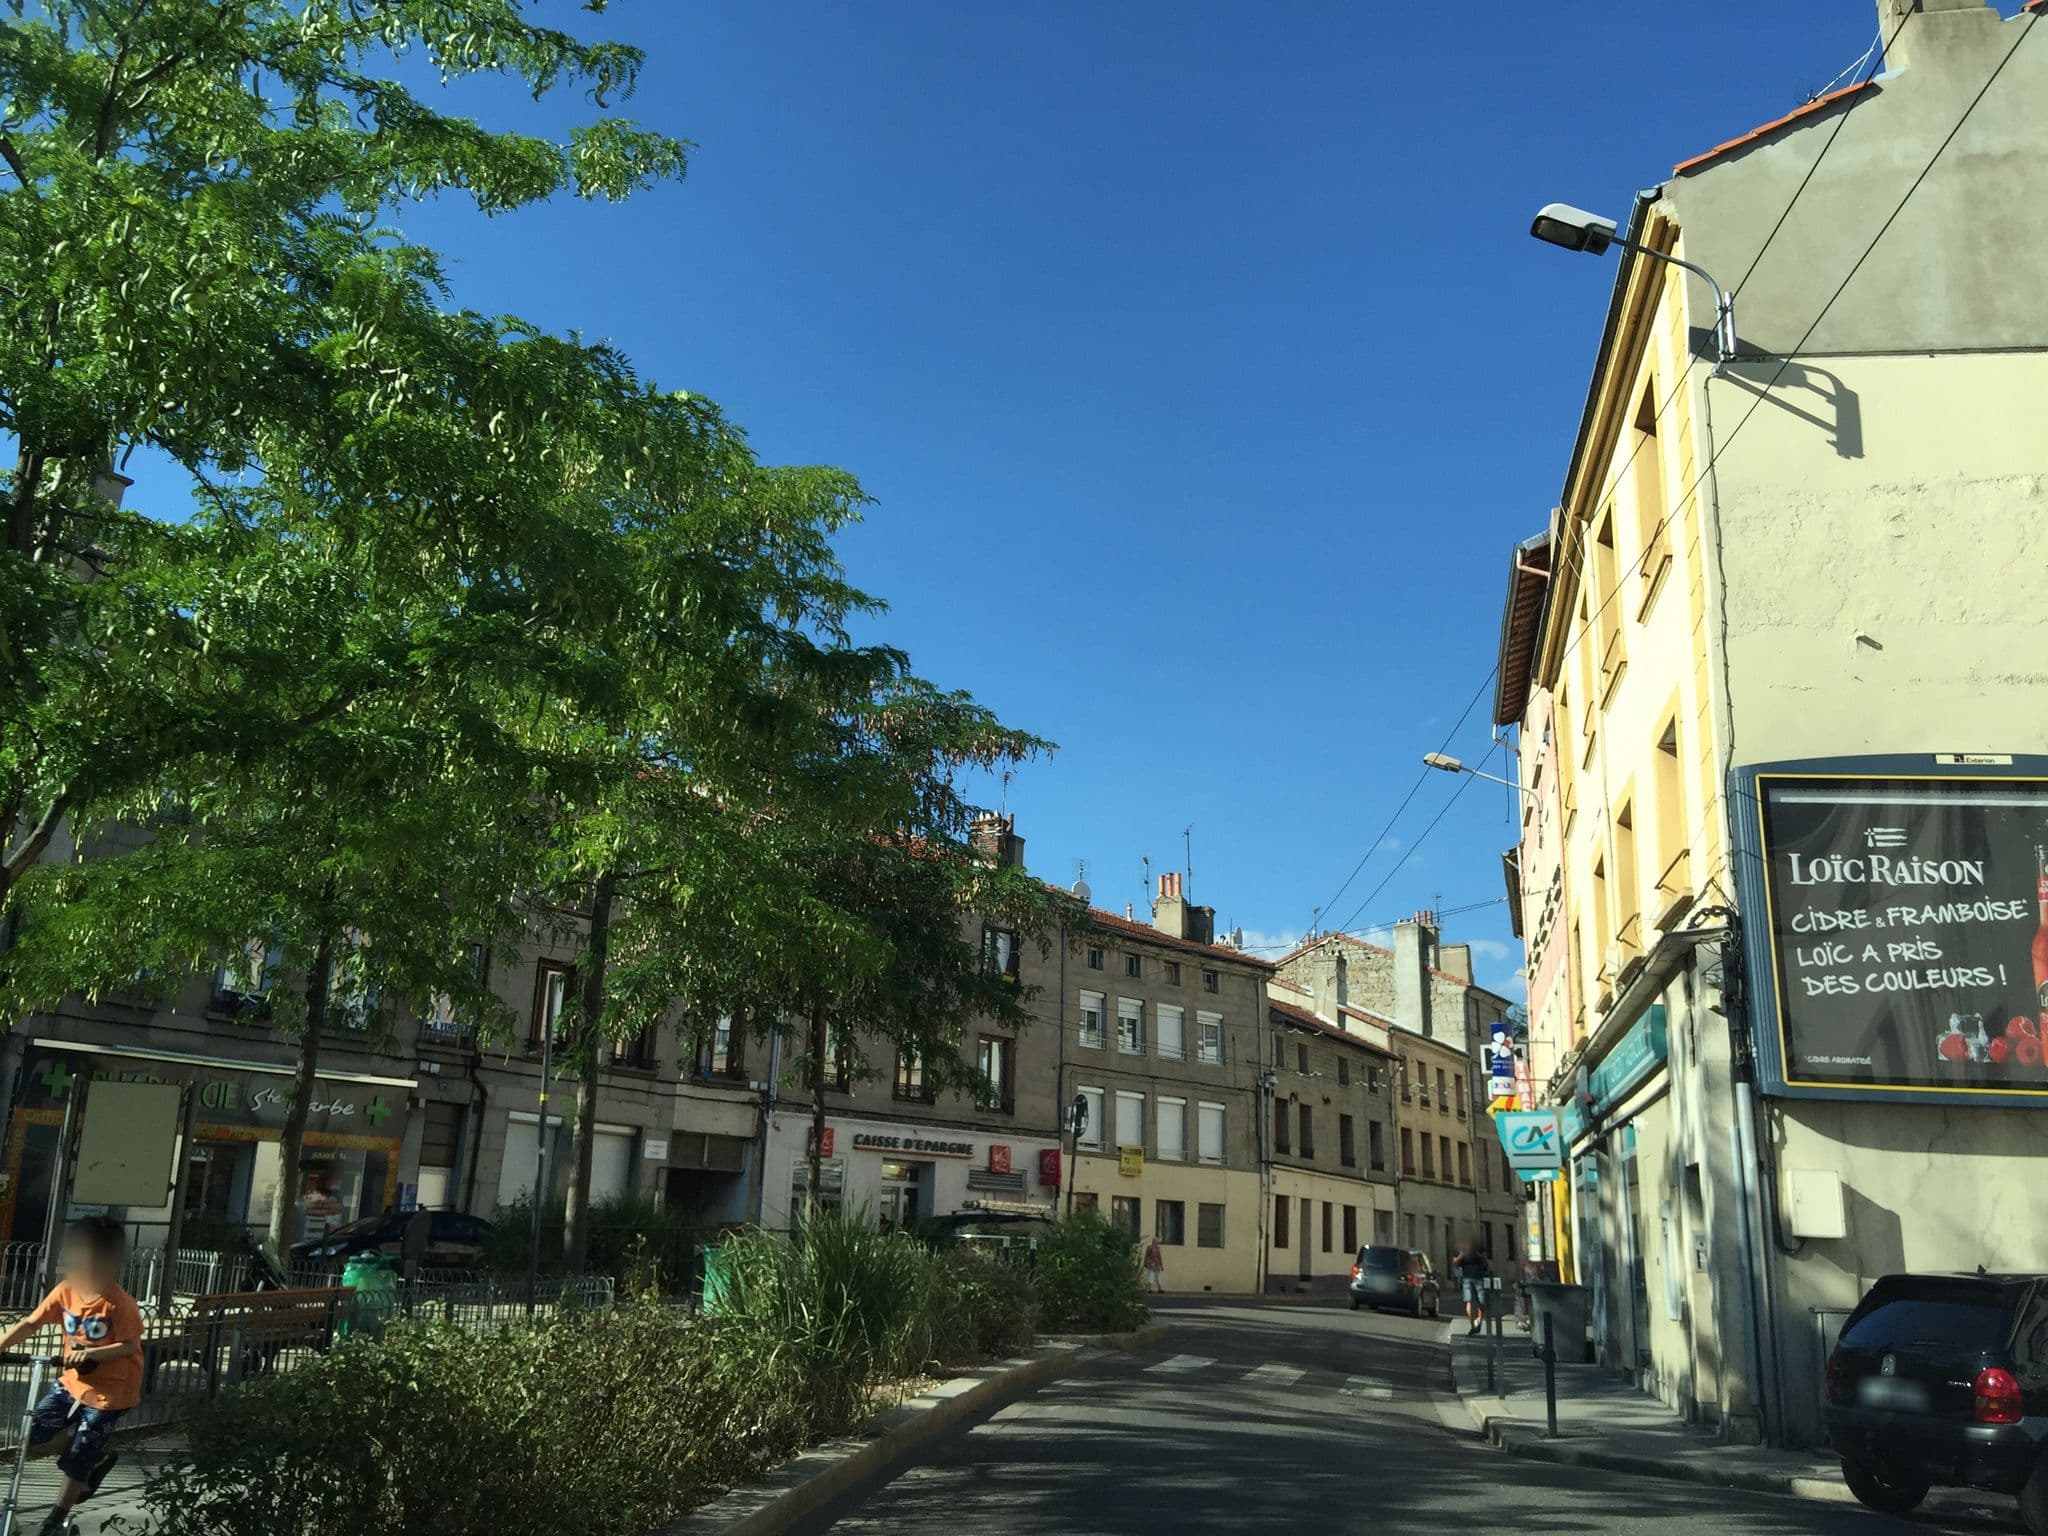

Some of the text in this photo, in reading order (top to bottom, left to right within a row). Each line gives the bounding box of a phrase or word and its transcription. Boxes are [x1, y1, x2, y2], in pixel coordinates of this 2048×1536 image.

[1788, 853, 1985, 886] LOÏC RAISON
[1791, 906, 1872, 932] CIDRE
[1875, 916, 1886, 928] &
[1797, 935, 1943, 967] LOÏC A PRIS
[1801, 975, 1860, 996] DES
[1865, 966, 1995, 992] COULEURS
[853, 1133, 900, 1149] CAISSE
